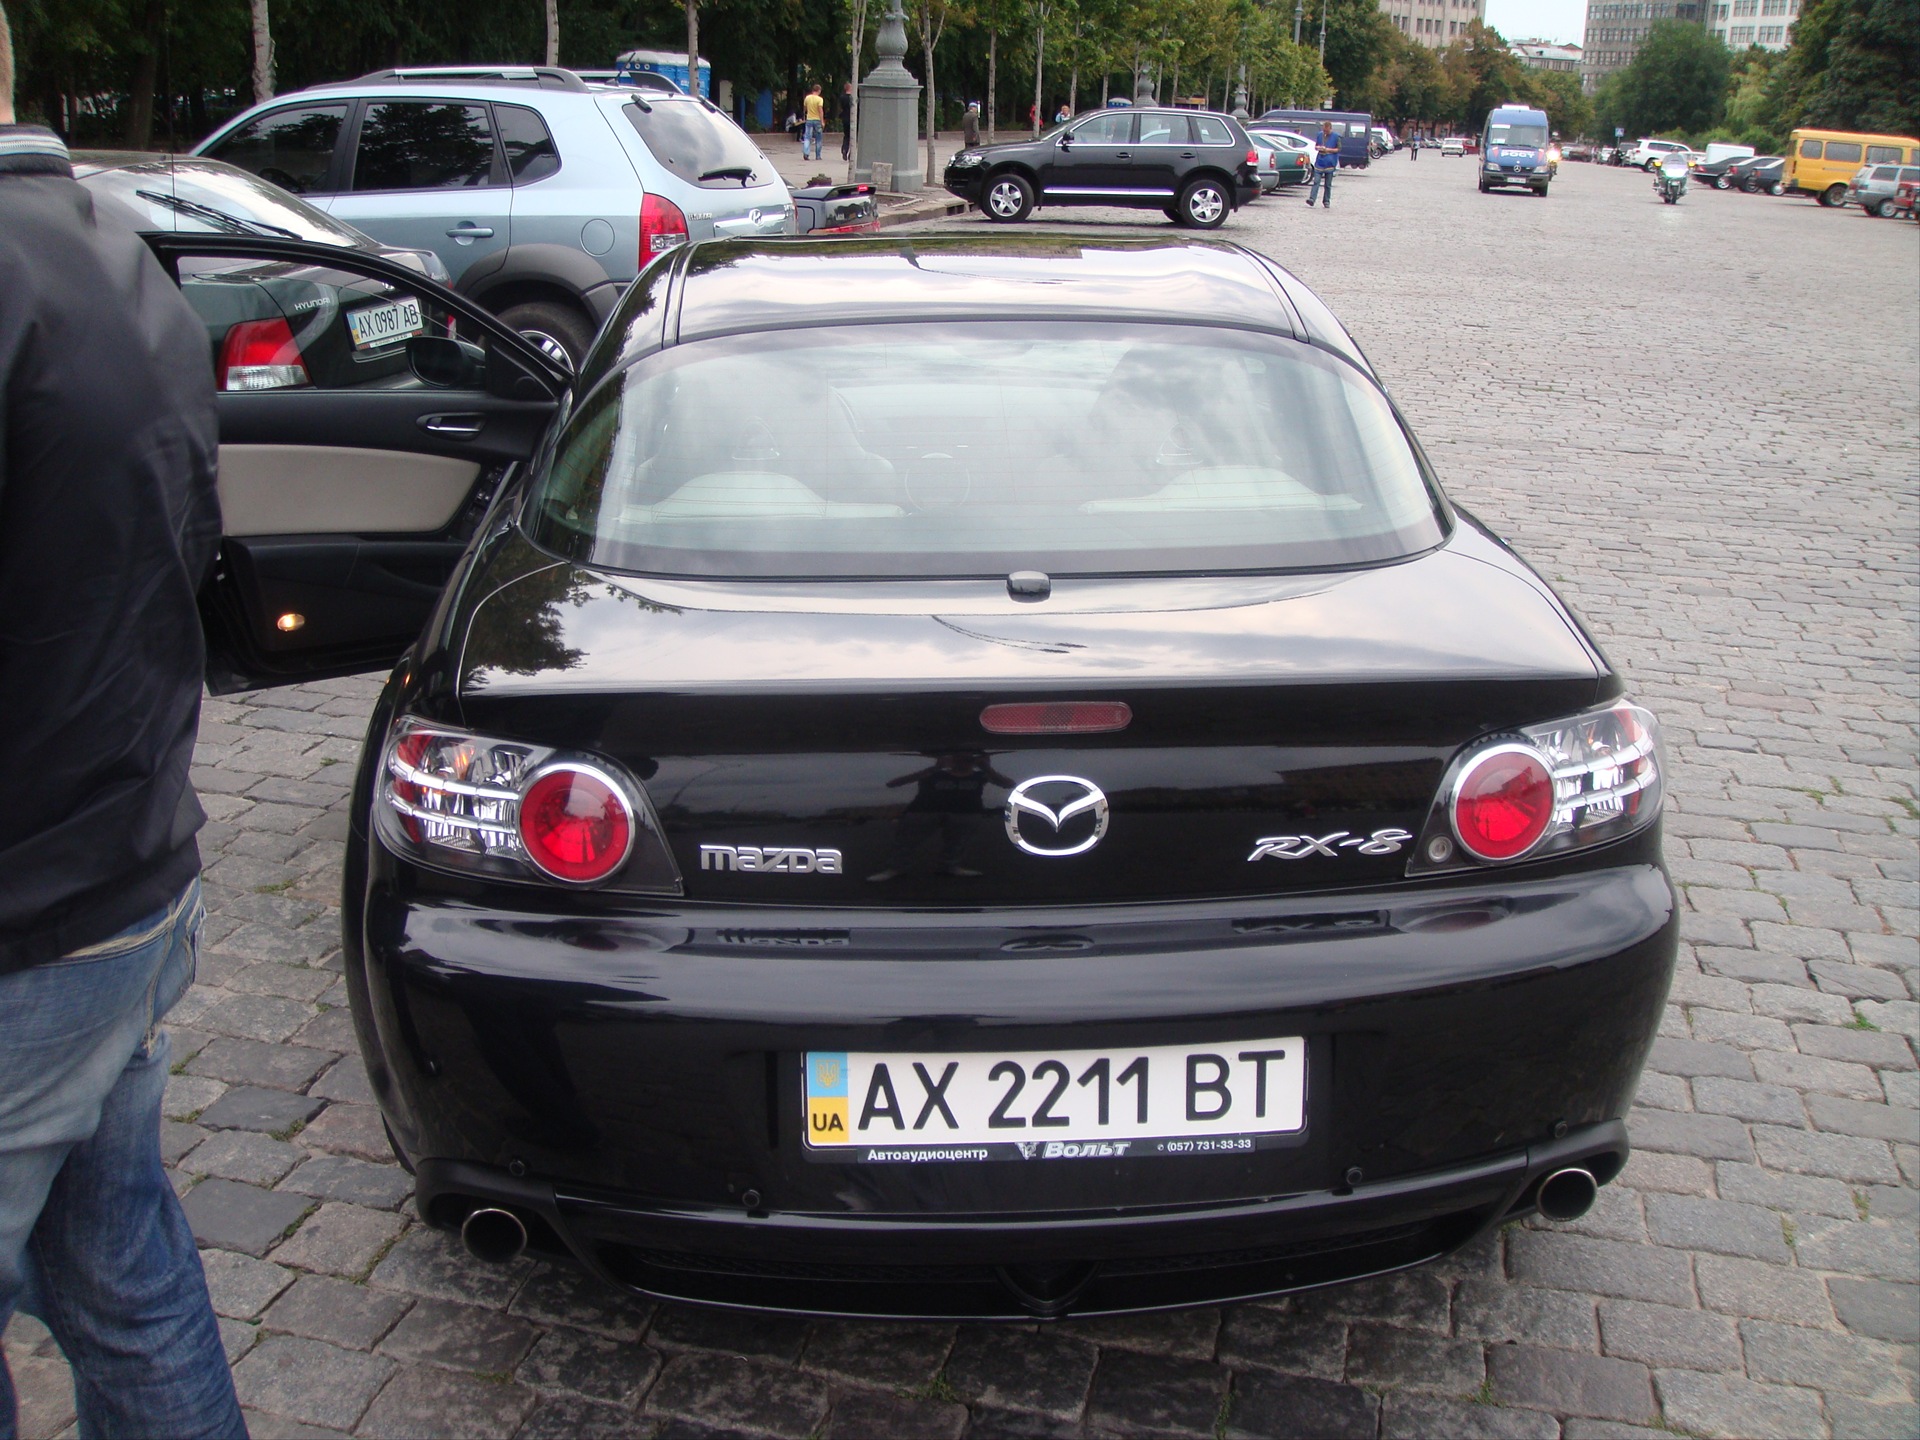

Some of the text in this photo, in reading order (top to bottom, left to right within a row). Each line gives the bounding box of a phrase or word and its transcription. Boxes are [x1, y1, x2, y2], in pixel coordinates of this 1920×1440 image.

[294, 297, 331, 311] HYUNDAI
[358, 304, 420, 339] AX 0987 AB
[1247, 828, 1413, 861] RX-8
[857, 1049, 1286, 1131] AX 2211 BT
[812, 1113, 845, 1133] UA
[867, 1148, 988, 1163] Автоаудиоцентр
[1041, 1141, 1131, 1159] Вольт
[1167, 1140, 1194, 1153] (057)
[1196, 1138, 1252, 1151] 731-33-33
